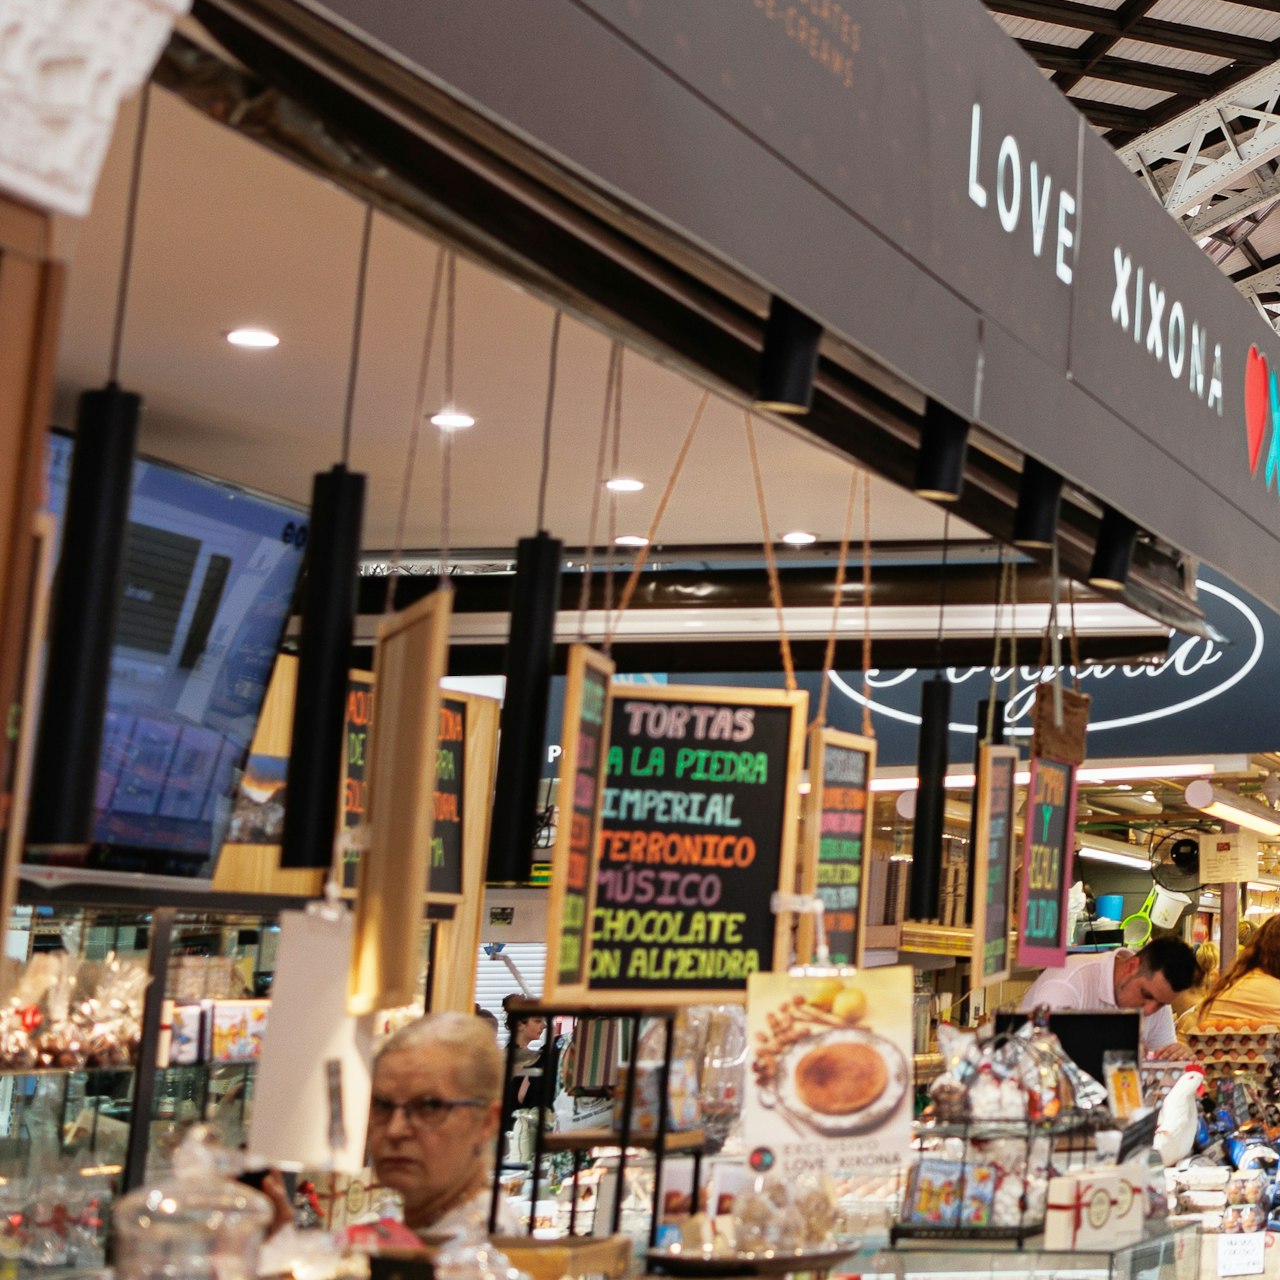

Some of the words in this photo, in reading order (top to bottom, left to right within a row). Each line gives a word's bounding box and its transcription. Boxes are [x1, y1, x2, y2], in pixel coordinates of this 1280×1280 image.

[968, 103, 1076, 285] LOVE
[1111, 246, 1224, 417] XIXONA
[624, 701, 755, 742] TORTAS
[605, 746, 623, 776] A
[631, 746, 665, 776] LA
[675, 748, 768, 784] PIEDRA
[601, 788, 741, 827] IMPERIAL
[598, 829, 756, 868] TERRONICO
[595, 864, 722, 906] MÚSICO
[590, 907, 746, 944] CHOCOLATE
[627, 947, 760, 980] ALMENDRA
